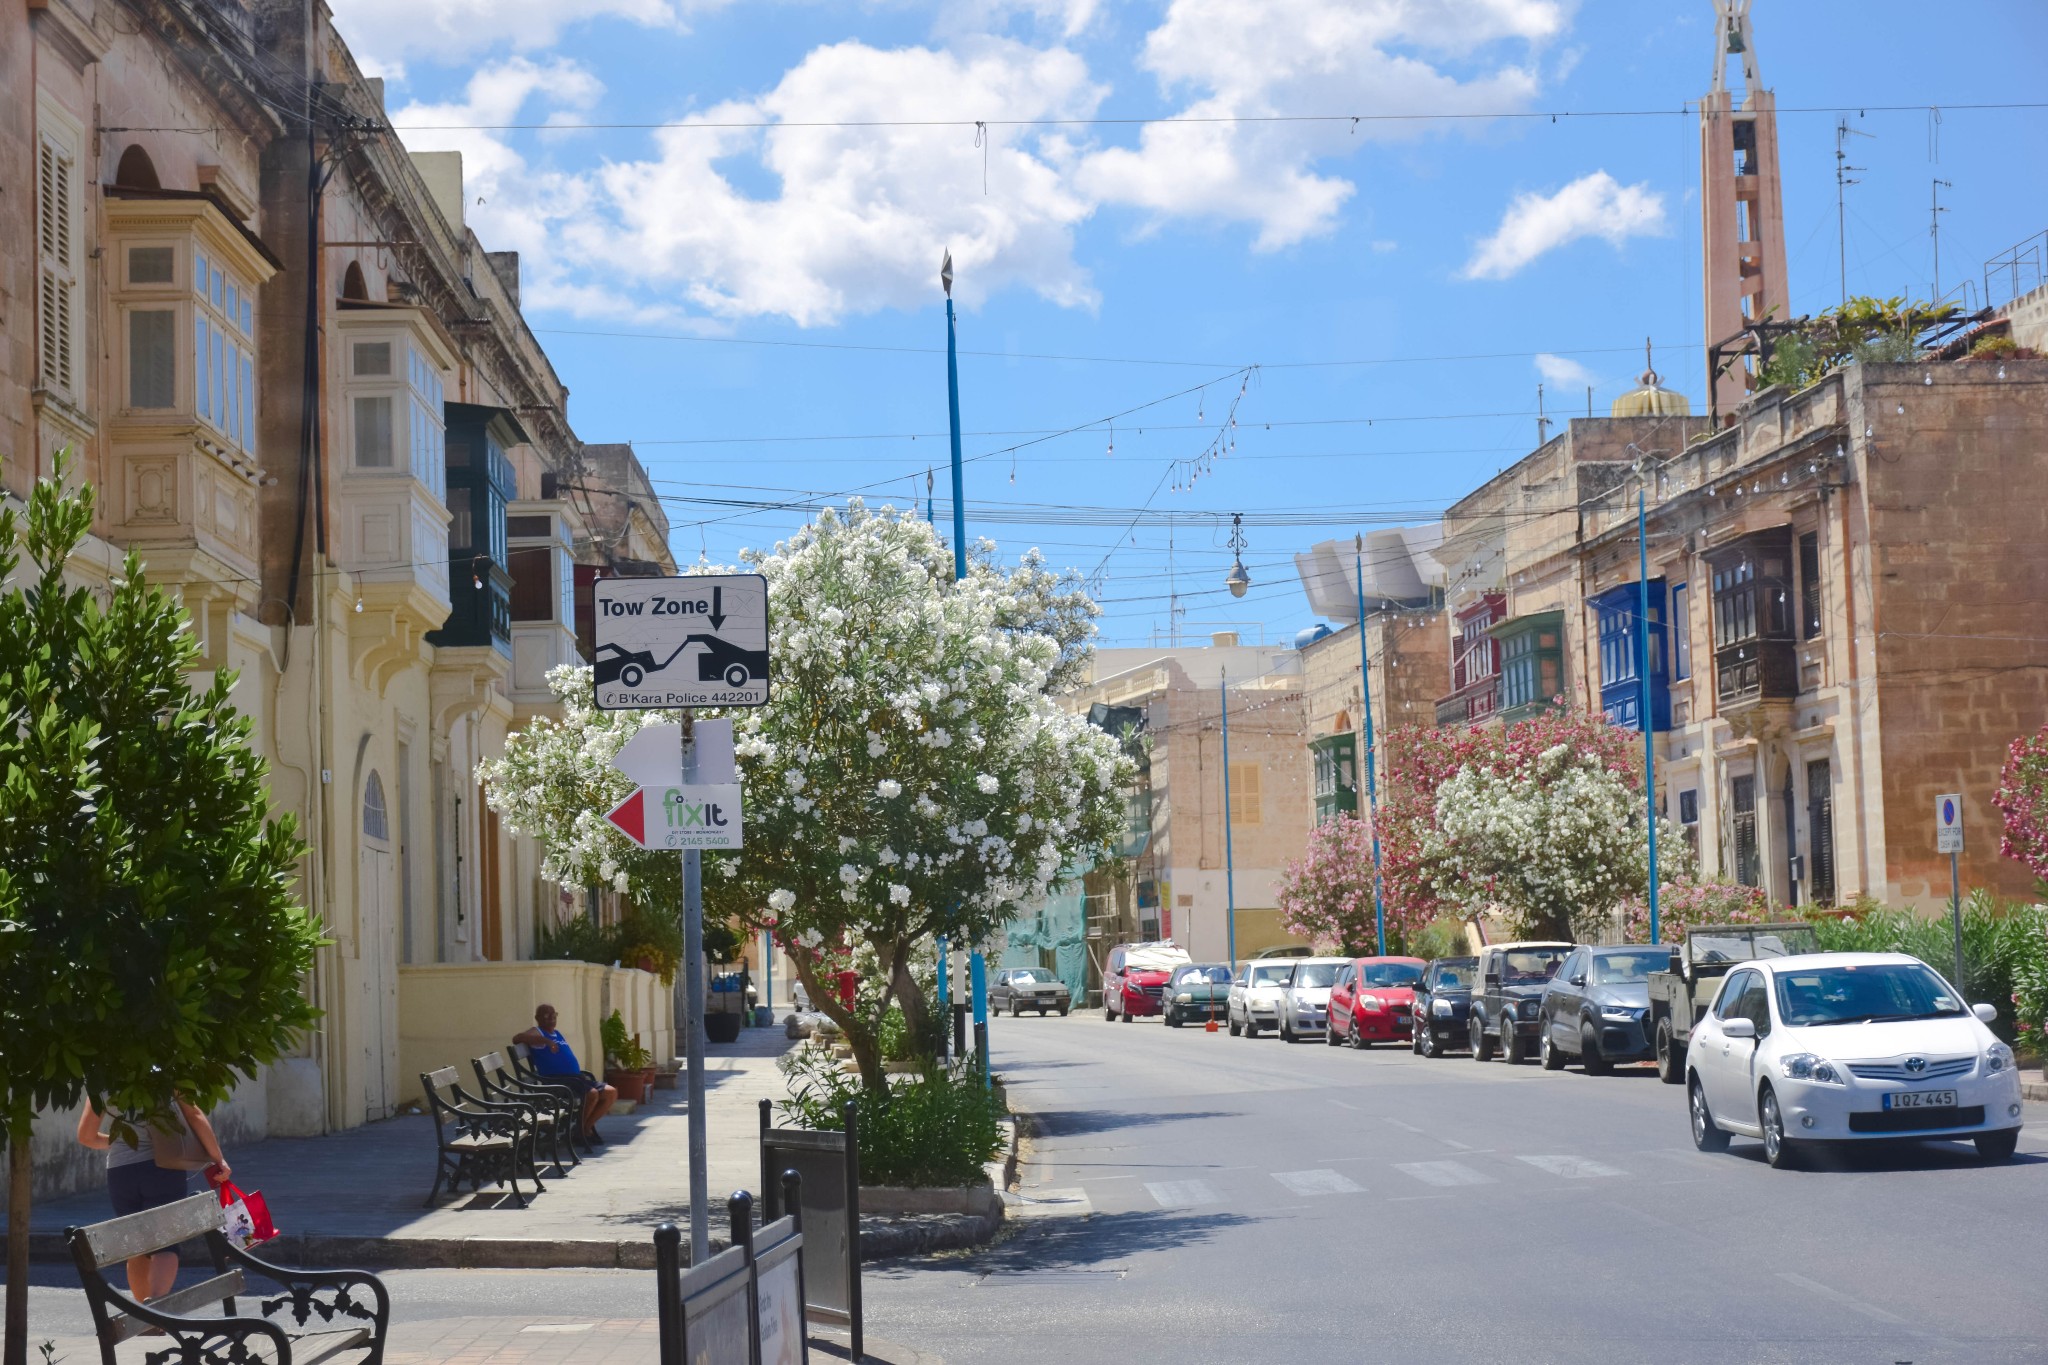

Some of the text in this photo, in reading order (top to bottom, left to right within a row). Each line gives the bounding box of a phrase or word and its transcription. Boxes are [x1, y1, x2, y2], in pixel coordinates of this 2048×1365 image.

[599, 597, 709, 616] Tow Zone
[619, 692, 759, 704] B'Kara Police 442201
[680, 837, 730, 845] 2145 5400
[1925, 1092, 1952, 1106] 445
